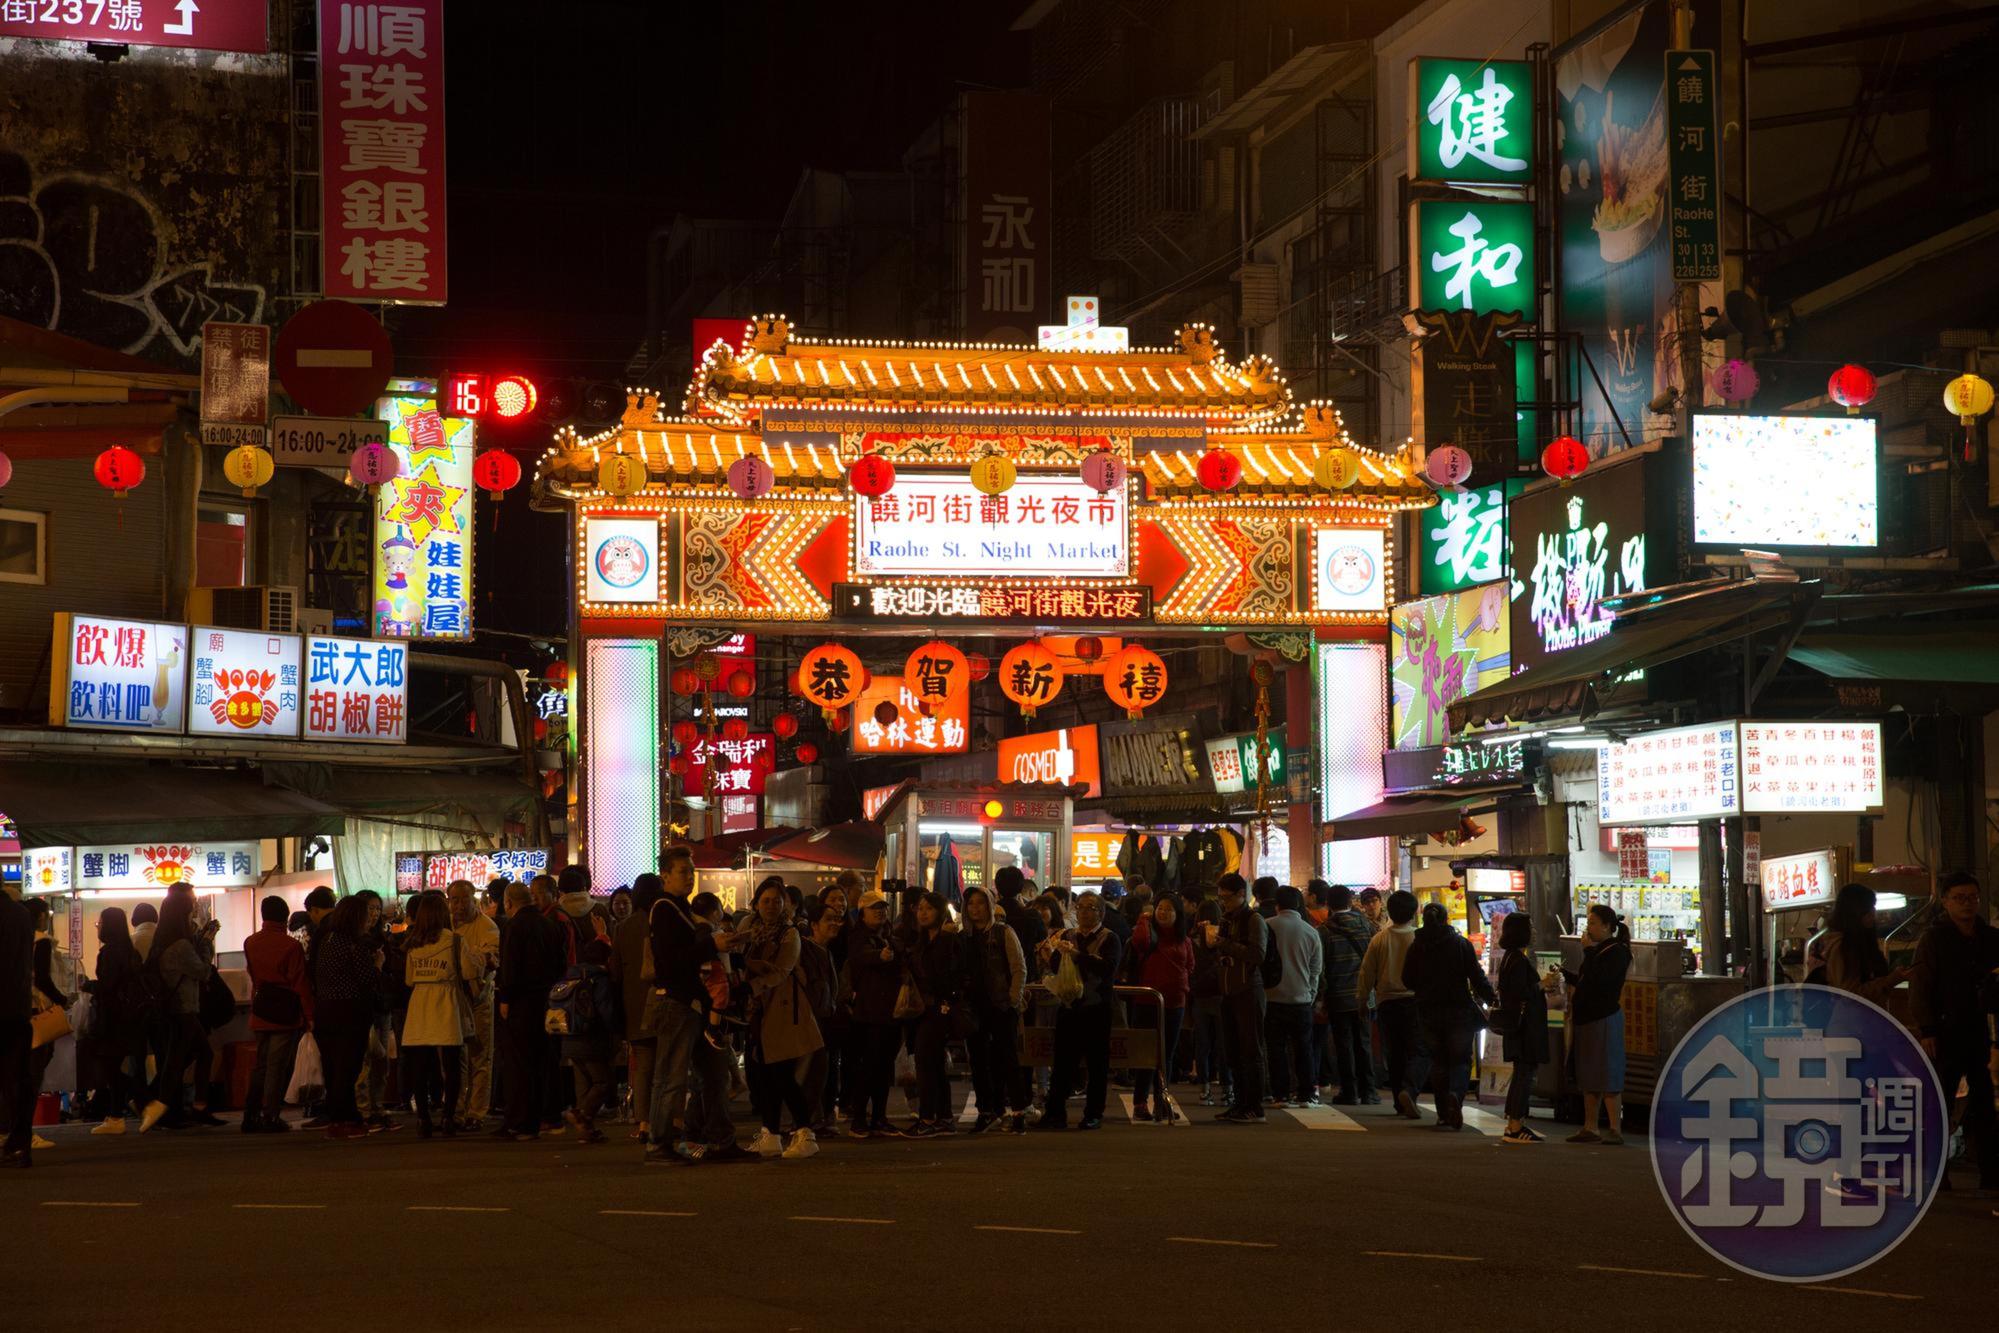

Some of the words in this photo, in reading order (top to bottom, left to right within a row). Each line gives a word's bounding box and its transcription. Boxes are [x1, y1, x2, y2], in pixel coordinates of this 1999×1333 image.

[338, 3, 429, 291] 順珠寶銀樓
[1676, 76, 1708, 201] 饒河街
[1673, 207, 1714, 220] RaoHe
[1674, 225, 1692, 239] St.
[983, 194, 1035, 312] 永和
[1677, 244, 1690, 256] 30
[1701, 244, 1714, 256] 33
[457, 380, 480, 414] 16
[204, 426, 264, 444] 16:00-24:00
[870, 494, 1116, 525] 饒河街觀光夜市
[869, 540, 929, 558] Raohe
[943, 540, 967, 558] St.
[980, 540, 1032, 562] Night
[1047, 540, 1118, 559] Market
[425, 540, 462, 633] 娃娃屋
[75, 623, 146, 669] 飲爆
[310, 641, 405, 689] 武大郎
[195, 656, 213, 706] 蟹腳
[281, 663, 297, 712] 蟹肉
[809, 657, 850, 700] 恭
[916, 653, 954, 698] 賀
[1012, 659, 1055, 699] 新
[1120, 661, 1162, 701] 禧
[70, 679, 152, 722] 飲料吧
[309, 688, 404, 738] 胡椒餅
[859, 717, 965, 748] 哈林運動
[1013, 748, 1058, 785] COSMED
[1719, 729, 1736, 808] 實在老口味
[1746, 729, 1762, 793] 苦茶退火
[492, 852, 547, 869] 不好吃
[1620, 832, 1646, 849] 熱
[206, 851, 252, 877] 蟹肉
[428, 855, 489, 890] 胡椒餅
